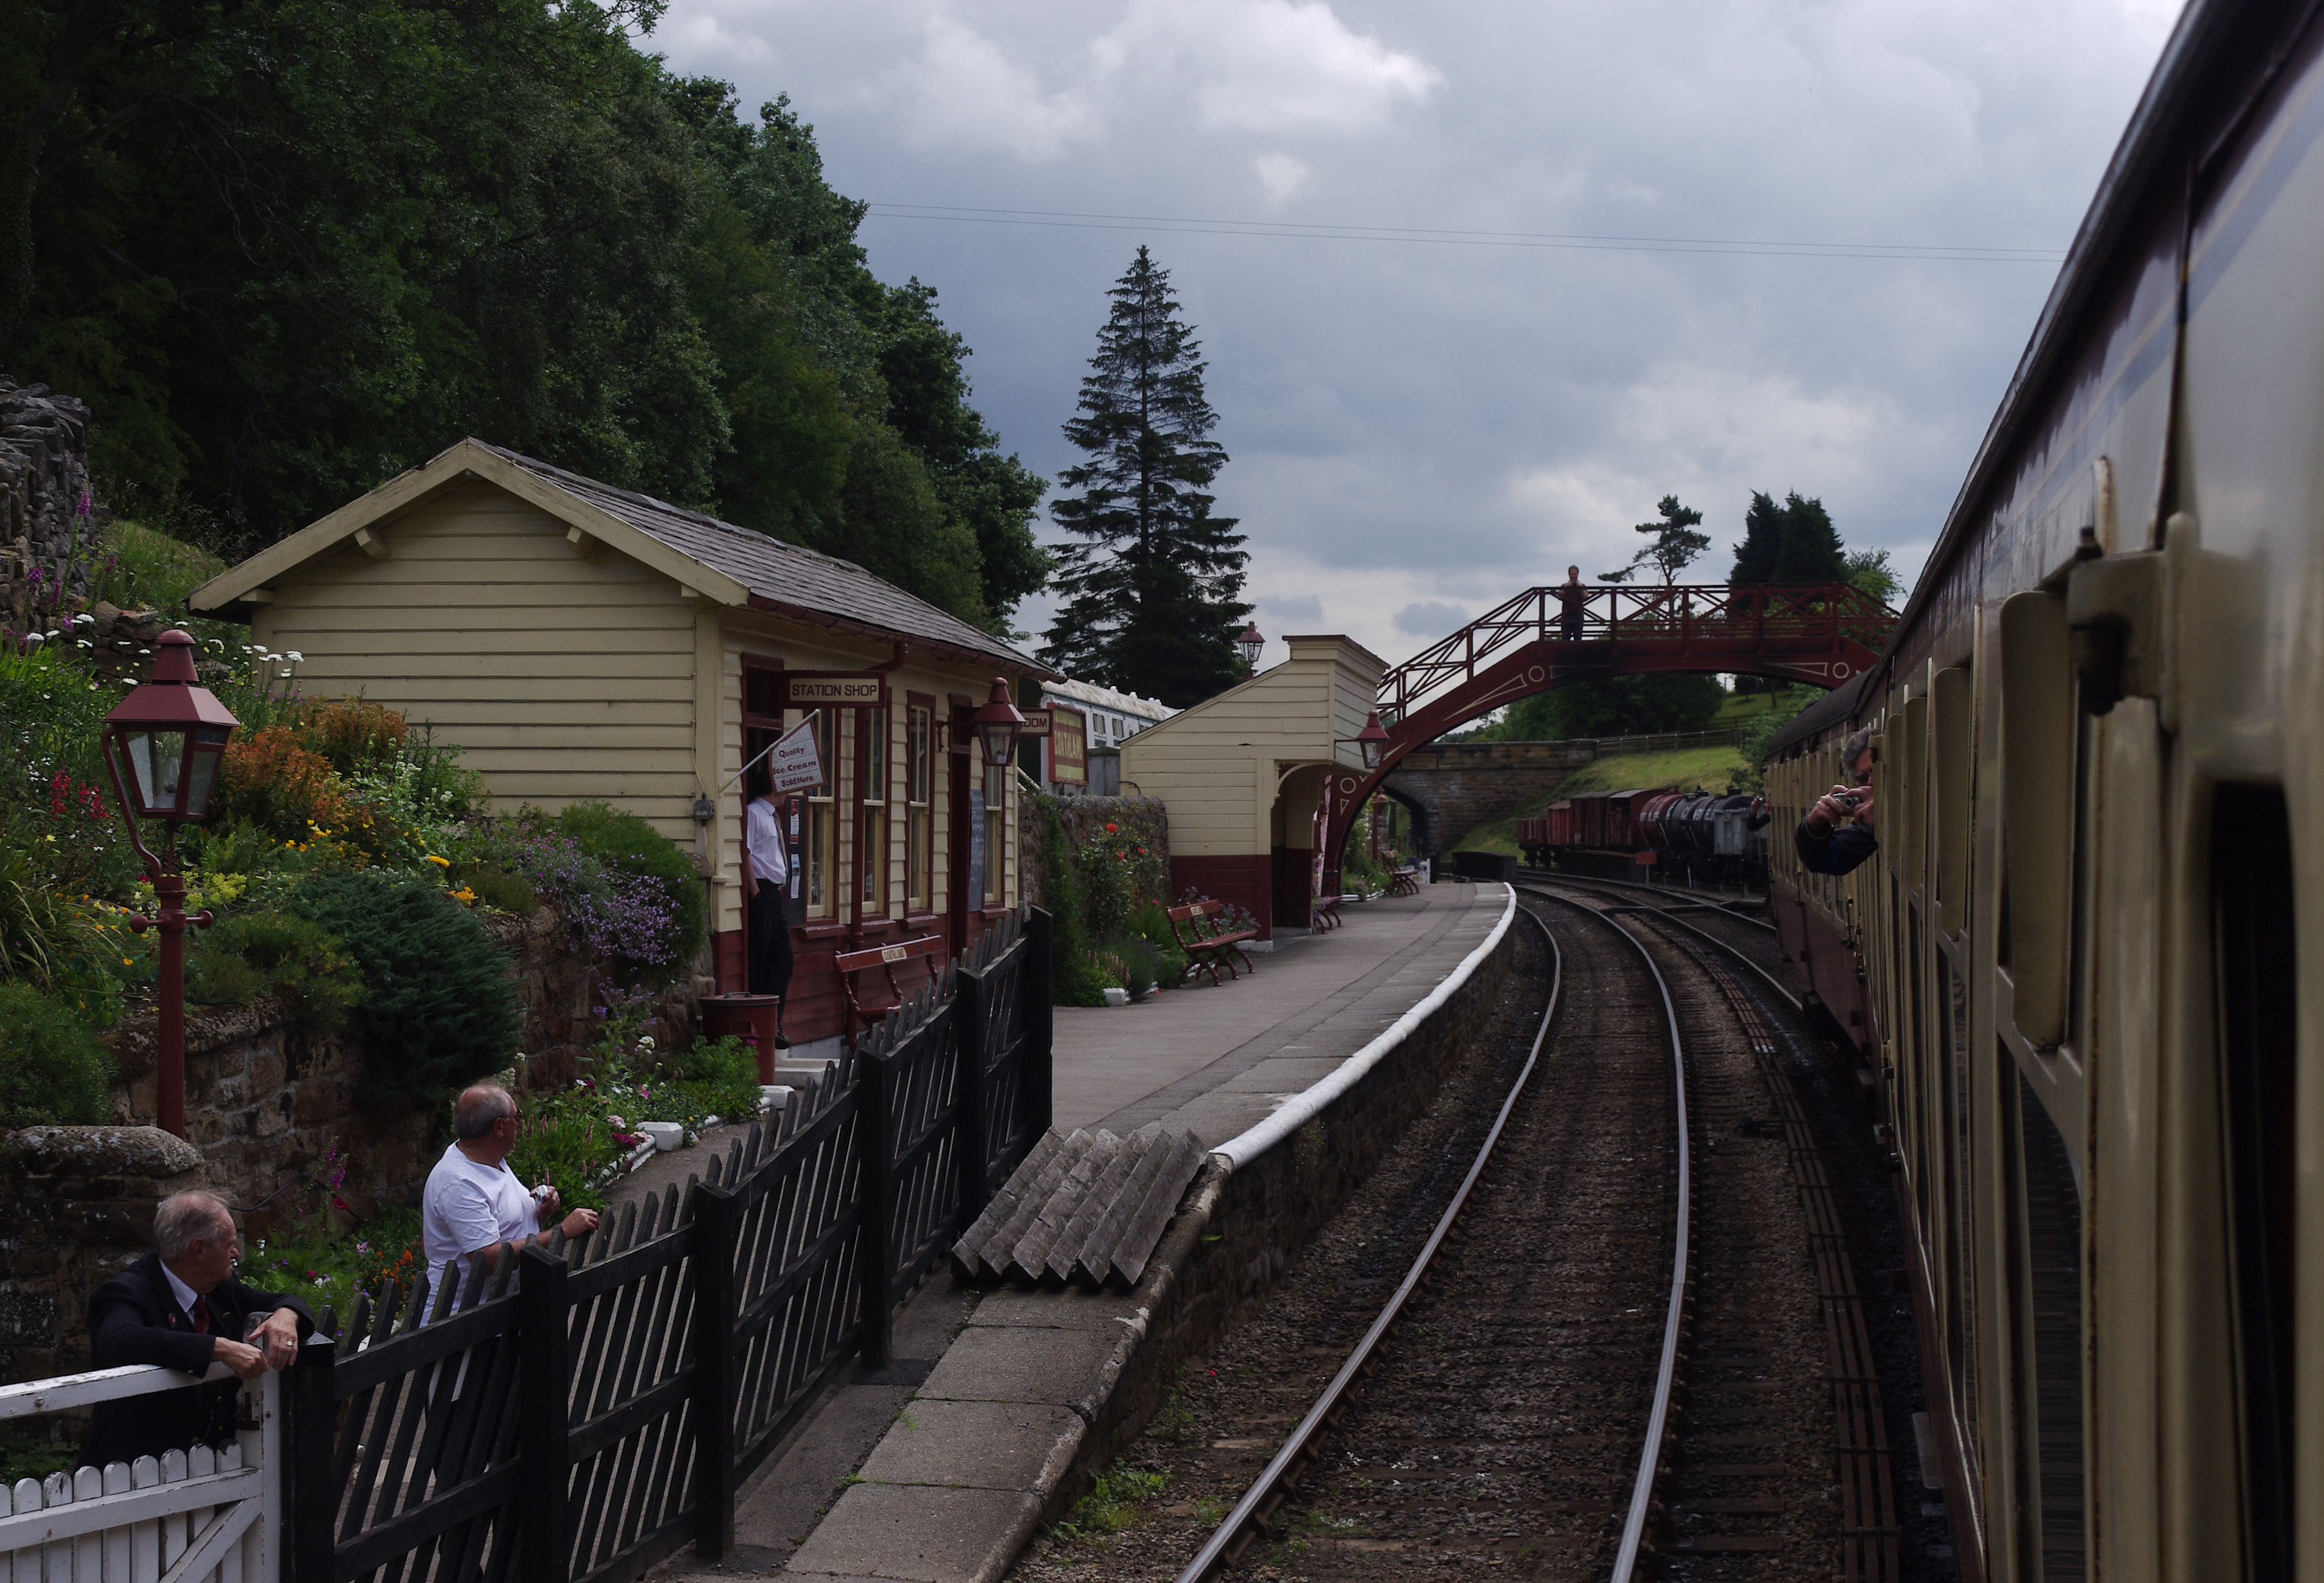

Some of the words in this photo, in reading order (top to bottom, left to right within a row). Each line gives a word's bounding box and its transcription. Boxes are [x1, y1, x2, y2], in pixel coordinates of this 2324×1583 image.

[792, 684, 841, 696] STATION
[845, 684, 877, 697] SHOP
[1021, 718, 1047, 727] OOM
[779, 747, 804, 758] Quality
[788, 761, 817, 771] Cream
[781, 778, 797, 787] Sold
